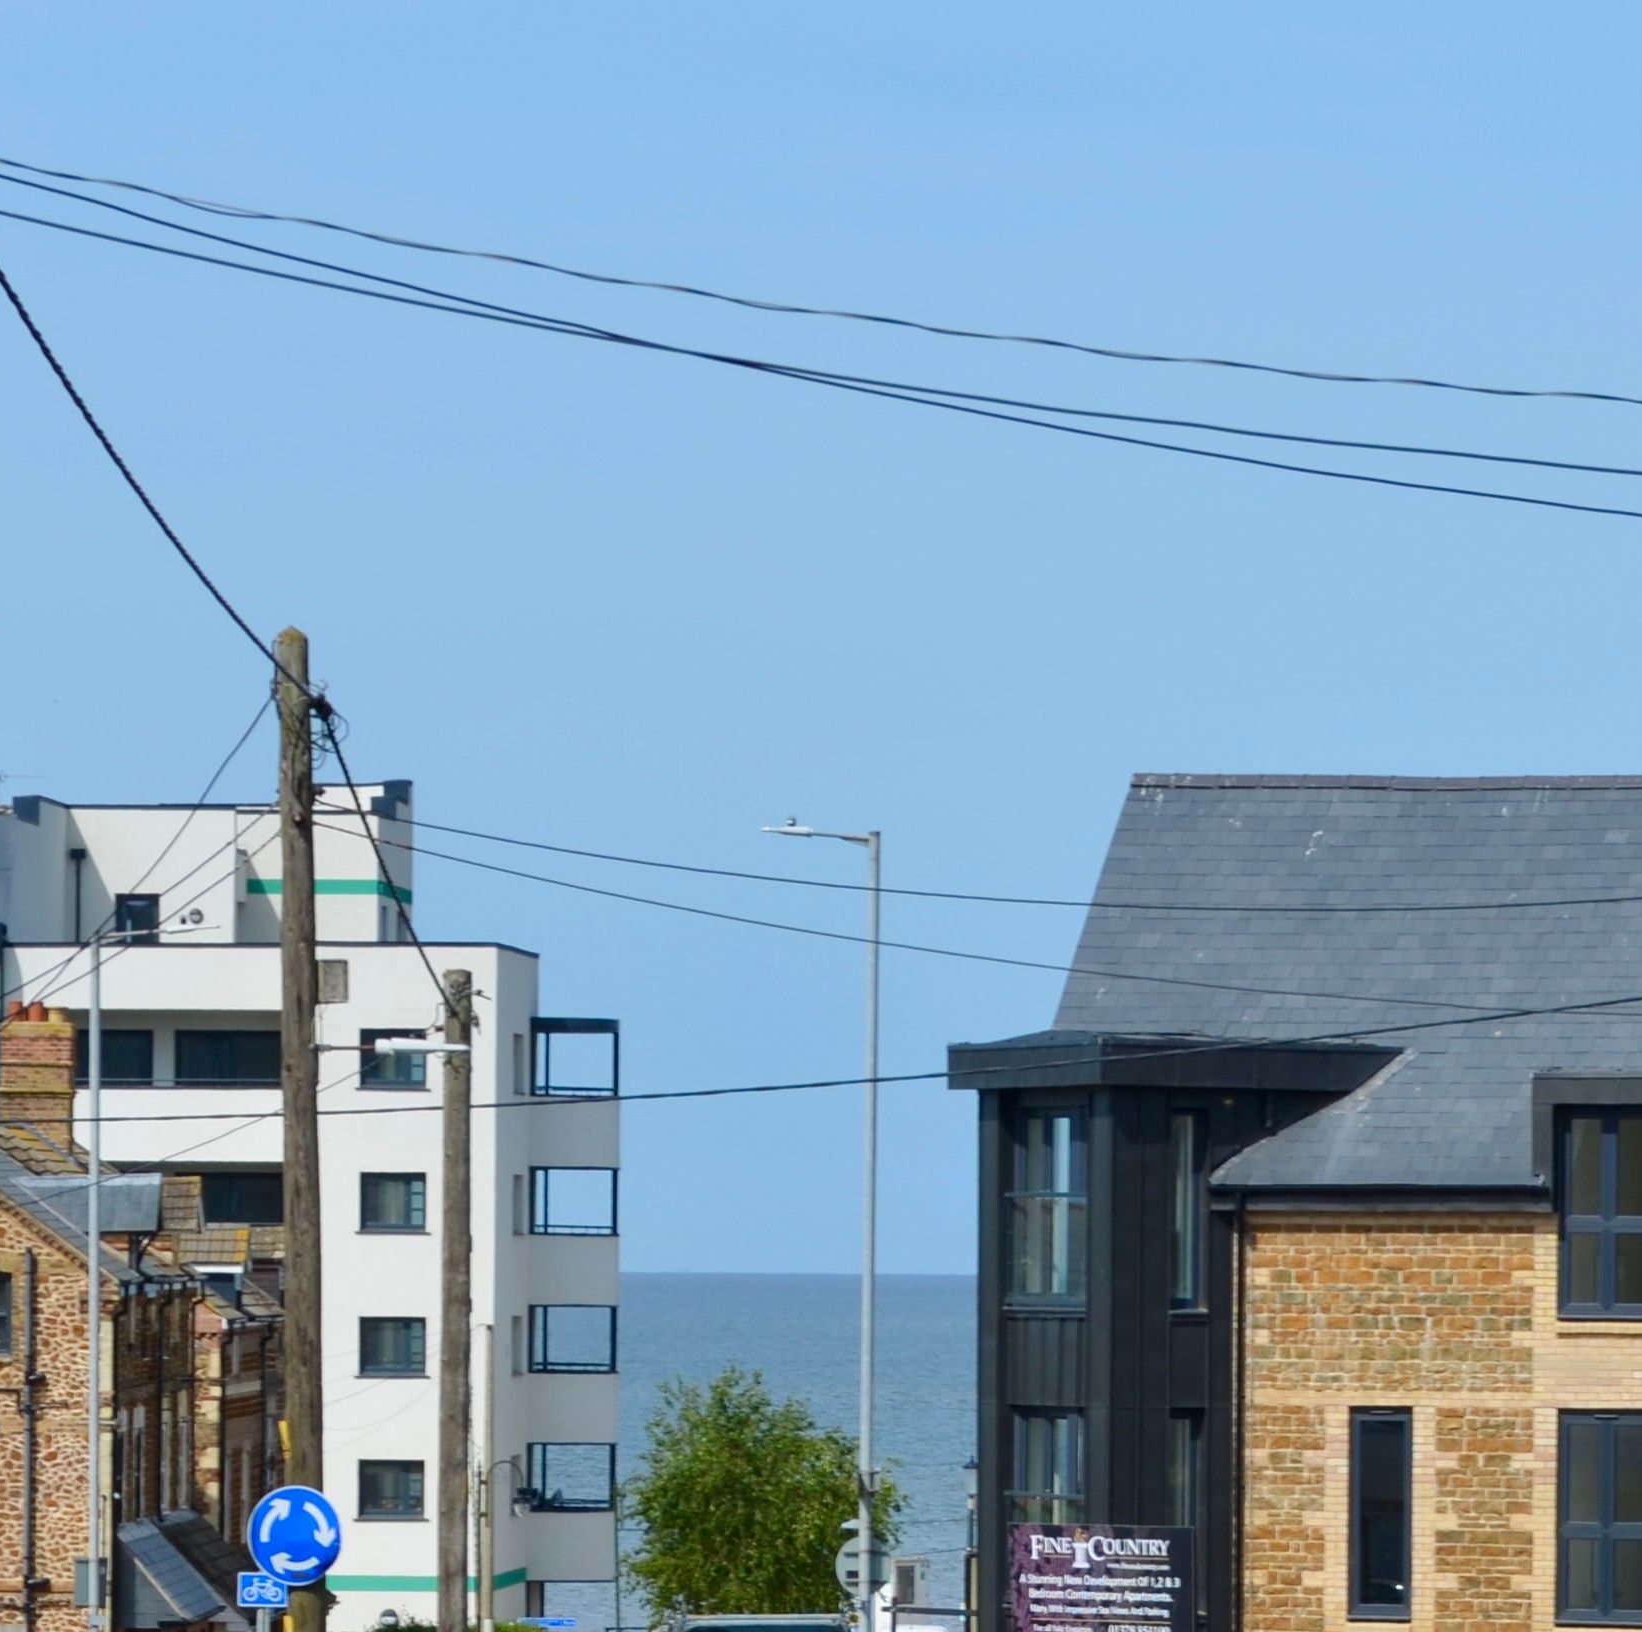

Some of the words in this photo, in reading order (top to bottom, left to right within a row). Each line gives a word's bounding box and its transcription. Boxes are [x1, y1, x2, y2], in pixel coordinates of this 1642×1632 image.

[1029, 1535, 1073, 1560] FINE
[1088, 1536, 1170, 1561] COUNTRY
[1019, 1574, 1026, 1584] A
[1027, 1573, 1063, 1587] Stunning
[1064, 1574, 1083, 1586] New
[1084, 1575, 1137, 1588] Development
[1173, 1577, 1181, 1588] 3
[1028, 1587, 1064, 1599] Bedroom
[1065, 1588, 1123, 1603] Contemporary
